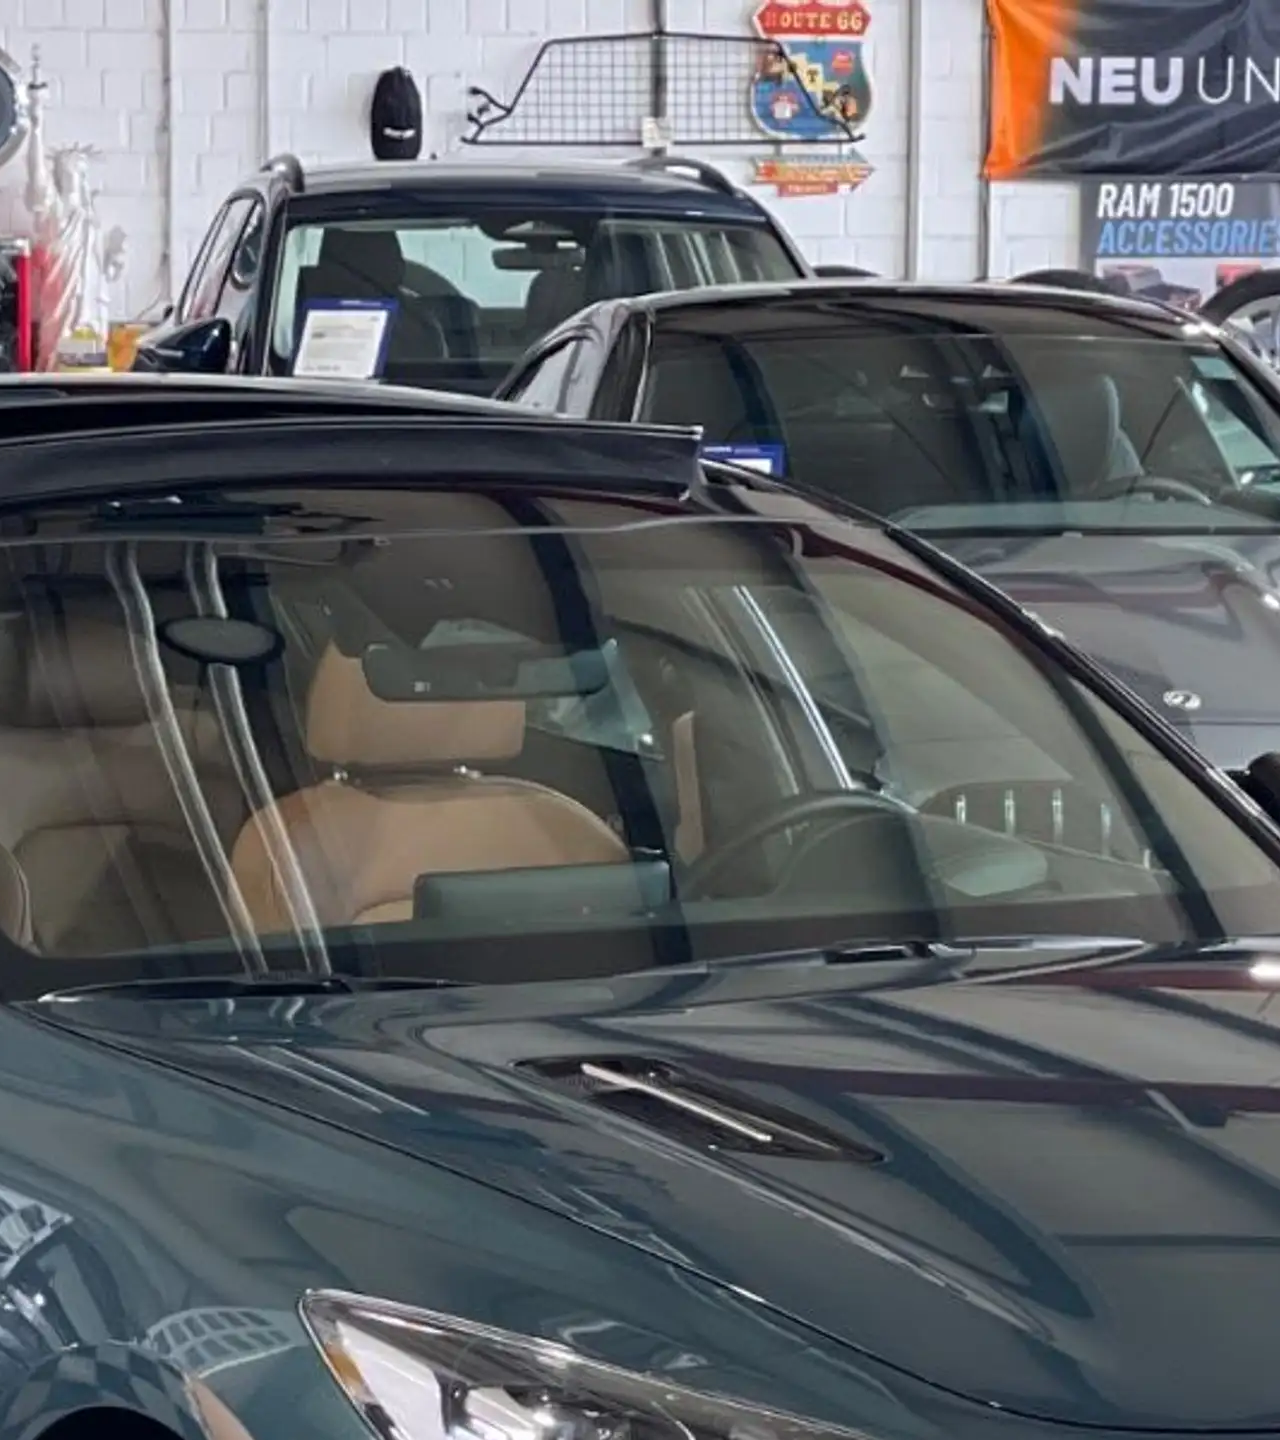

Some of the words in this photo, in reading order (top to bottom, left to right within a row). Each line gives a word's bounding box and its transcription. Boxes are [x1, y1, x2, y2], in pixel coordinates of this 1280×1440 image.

[836, 11, 863, 31] 66
[1048, 56, 1184, 105] NEU
[1096, 184, 1161, 217] RAM
[1169, 183, 1235, 218] 1500
